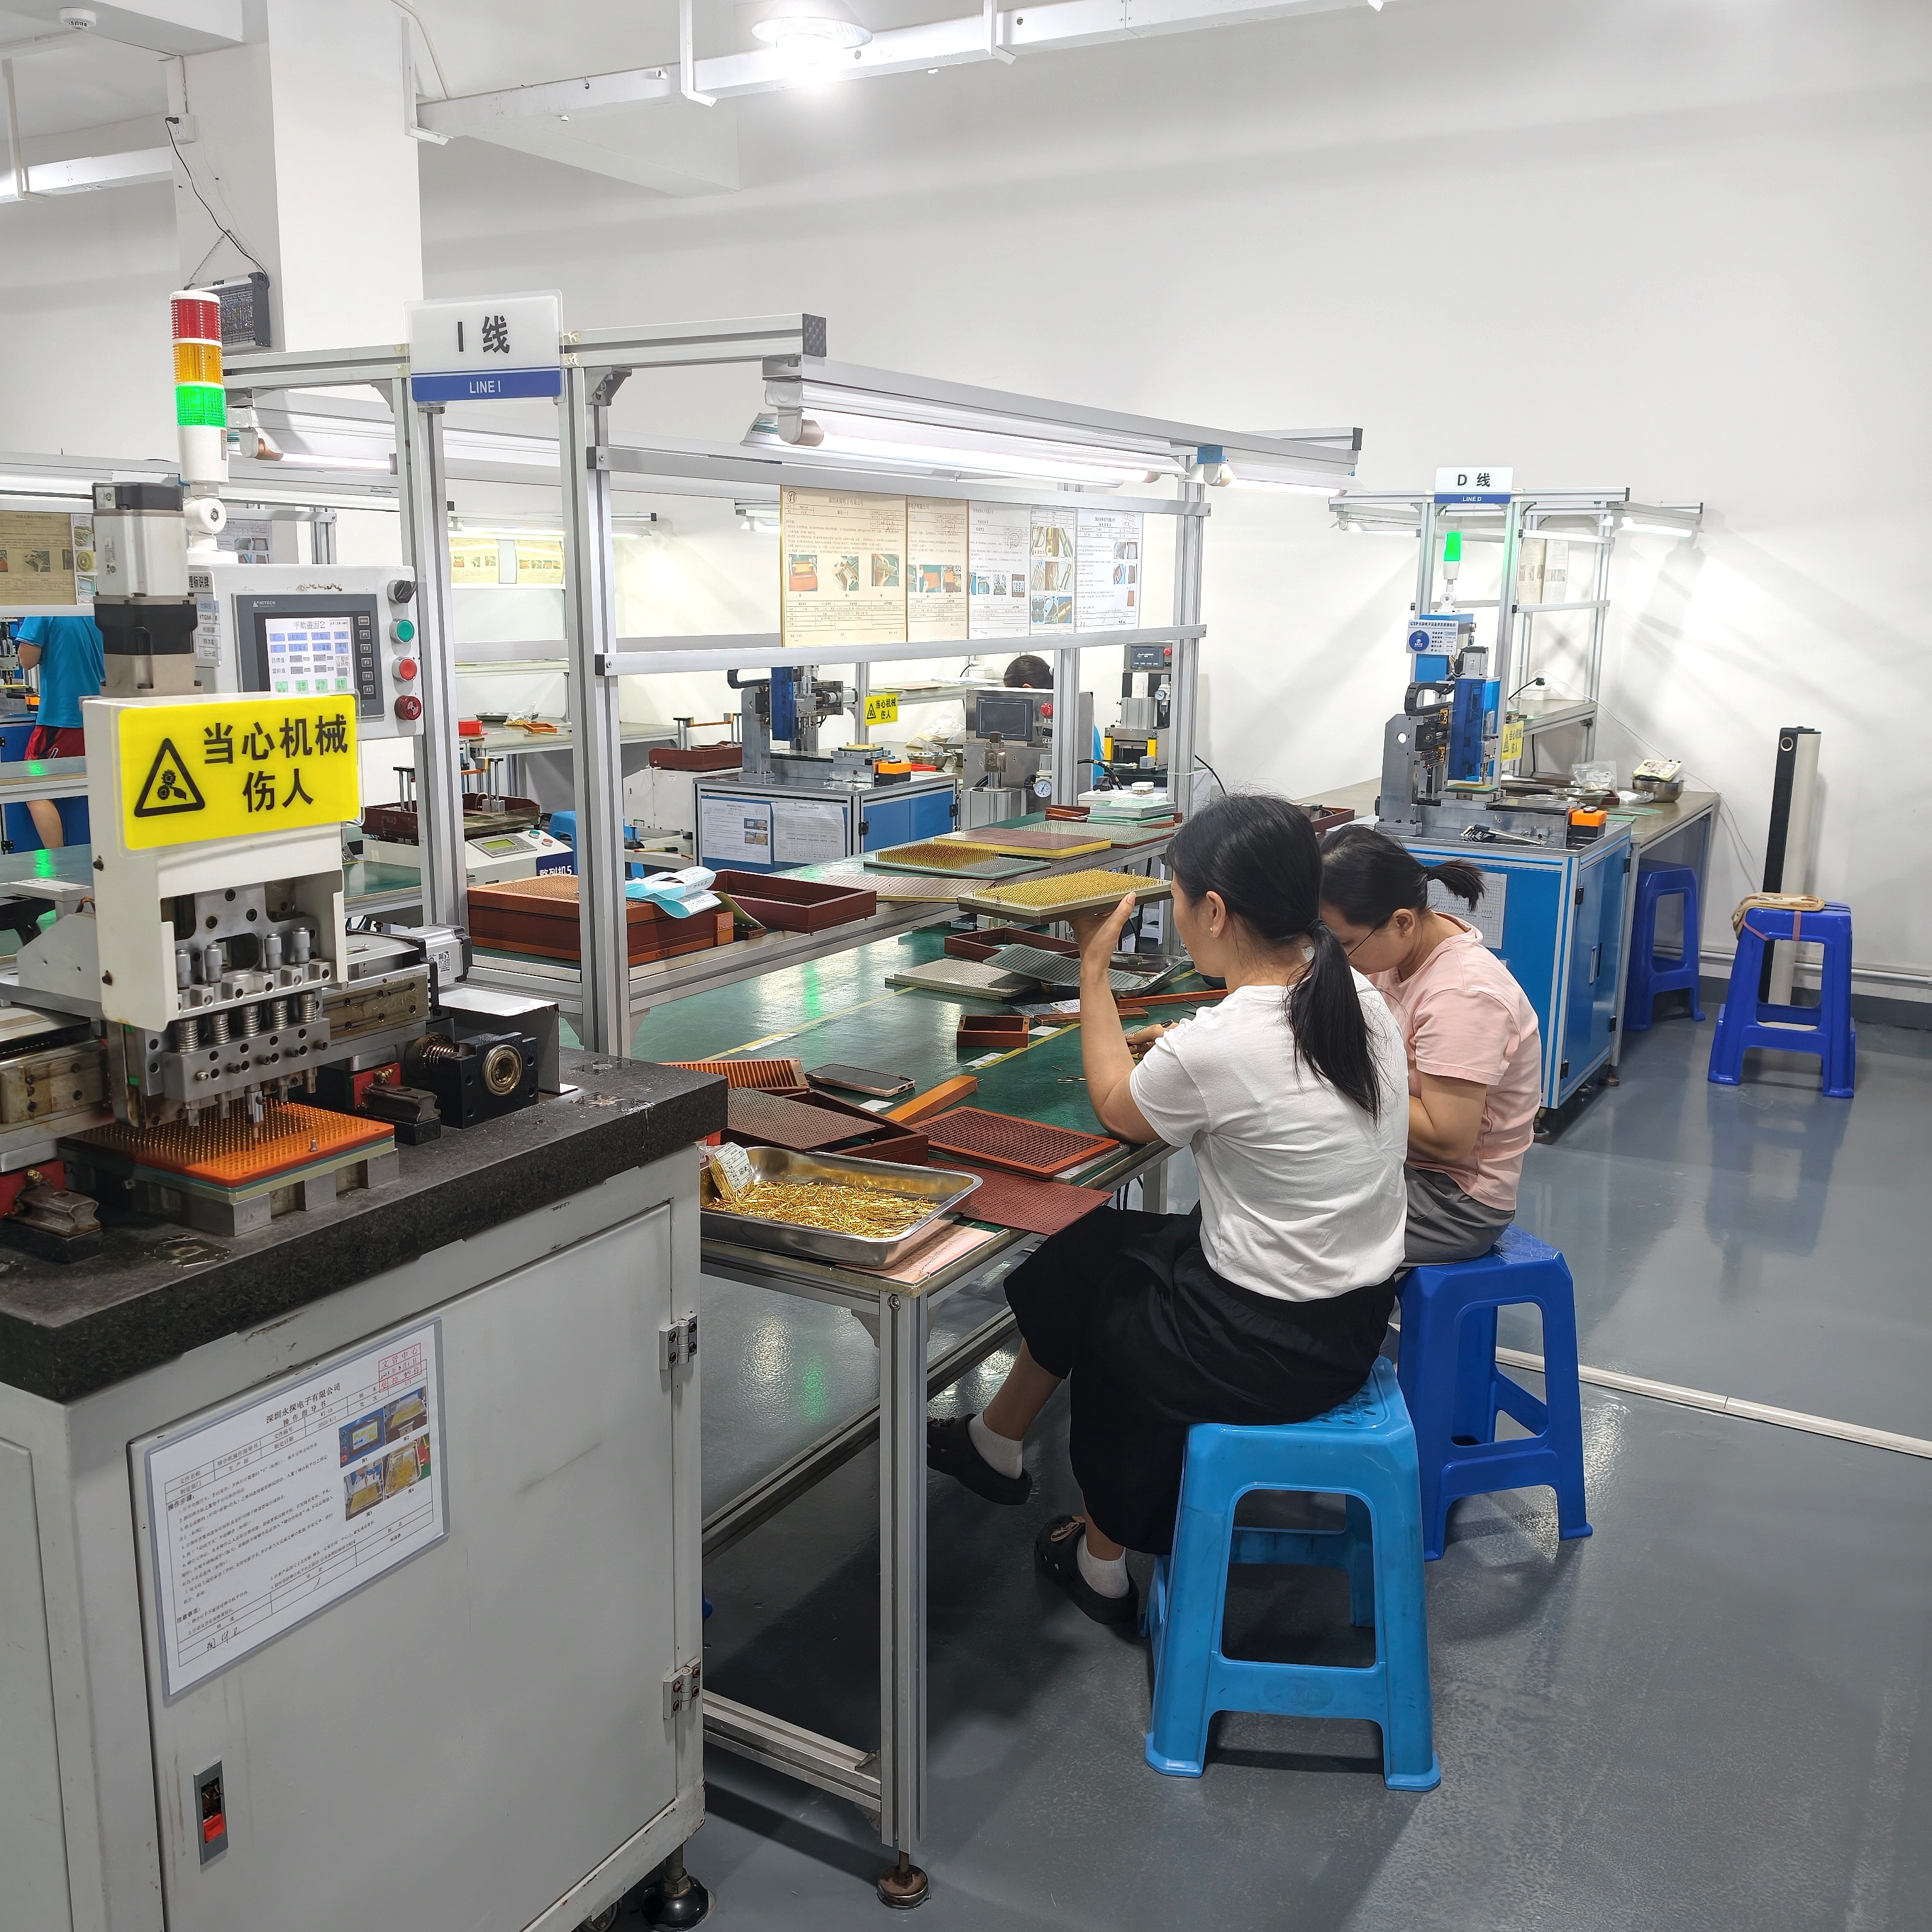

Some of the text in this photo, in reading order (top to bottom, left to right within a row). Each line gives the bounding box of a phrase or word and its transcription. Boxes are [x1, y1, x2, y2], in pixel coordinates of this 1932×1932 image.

[482, 315, 510, 353] 线
[469, 380, 496, 394] LINE
[1457, 473, 1491, 487] D 线
[204, 714, 348, 765] 当心机械
[242, 768, 314, 813] 伤人
[382, 1345, 418, 1370] 文管中心
